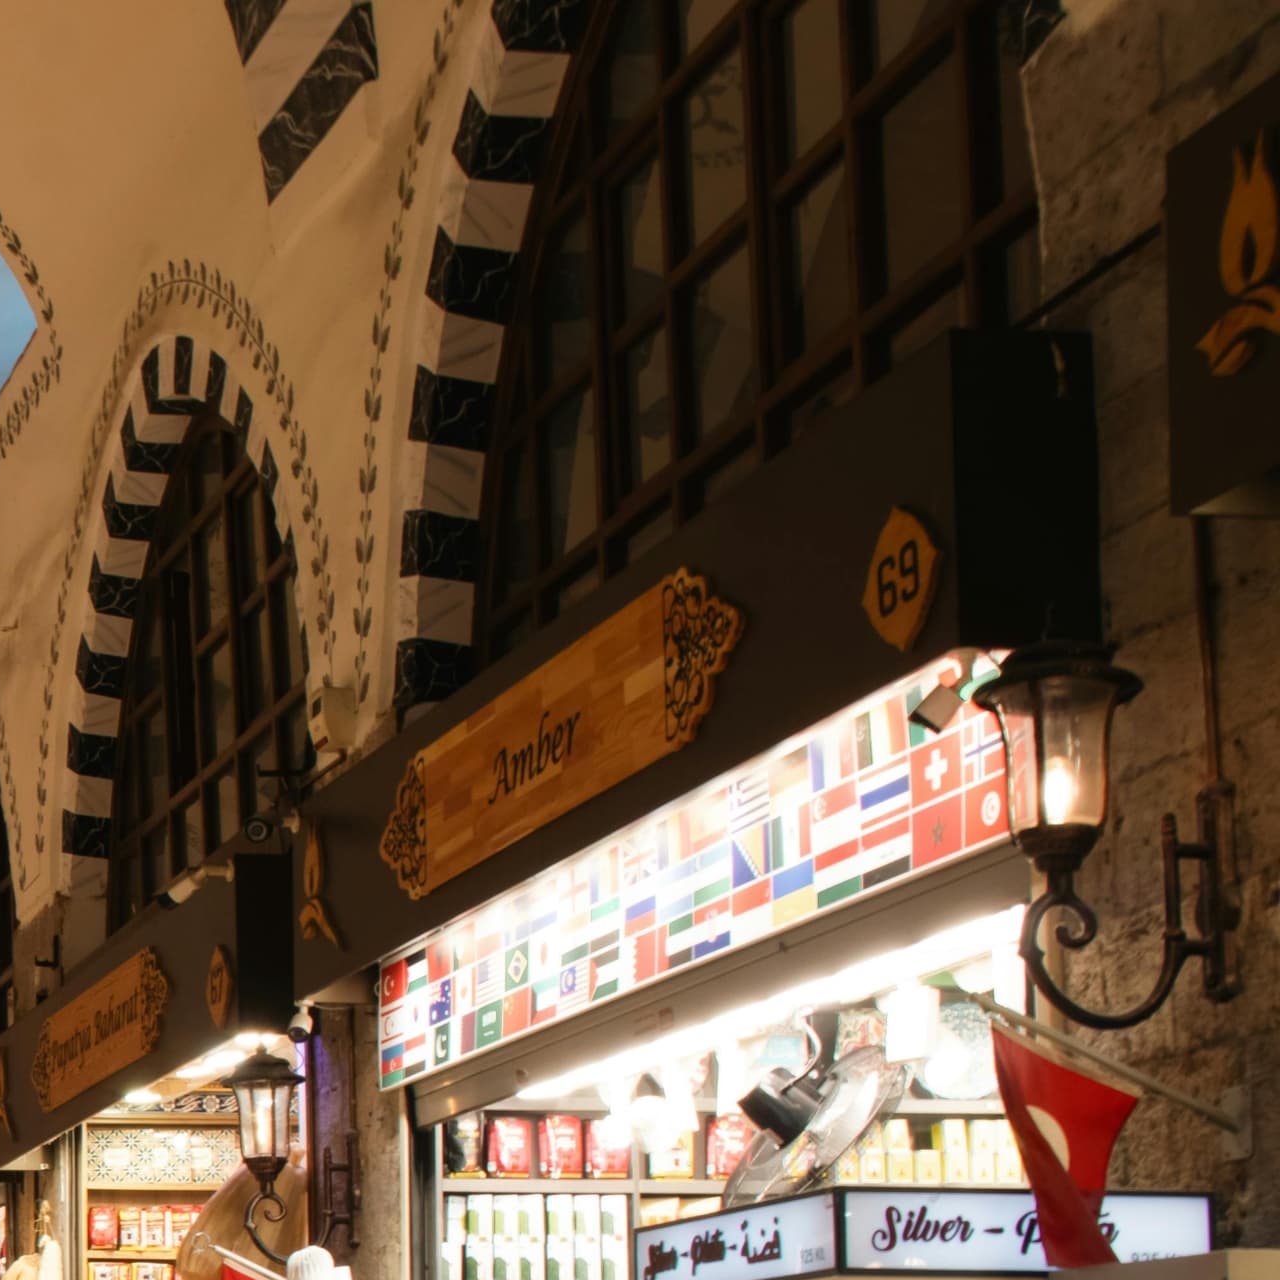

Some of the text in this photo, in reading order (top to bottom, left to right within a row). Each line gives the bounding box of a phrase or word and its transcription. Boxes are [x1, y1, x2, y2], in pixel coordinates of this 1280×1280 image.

[878, 540, 920, 619] 69
[488, 710, 581, 806] Amber
[210, 967, 224, 1006] 67
[872, 1205, 975, 1252] Silver
